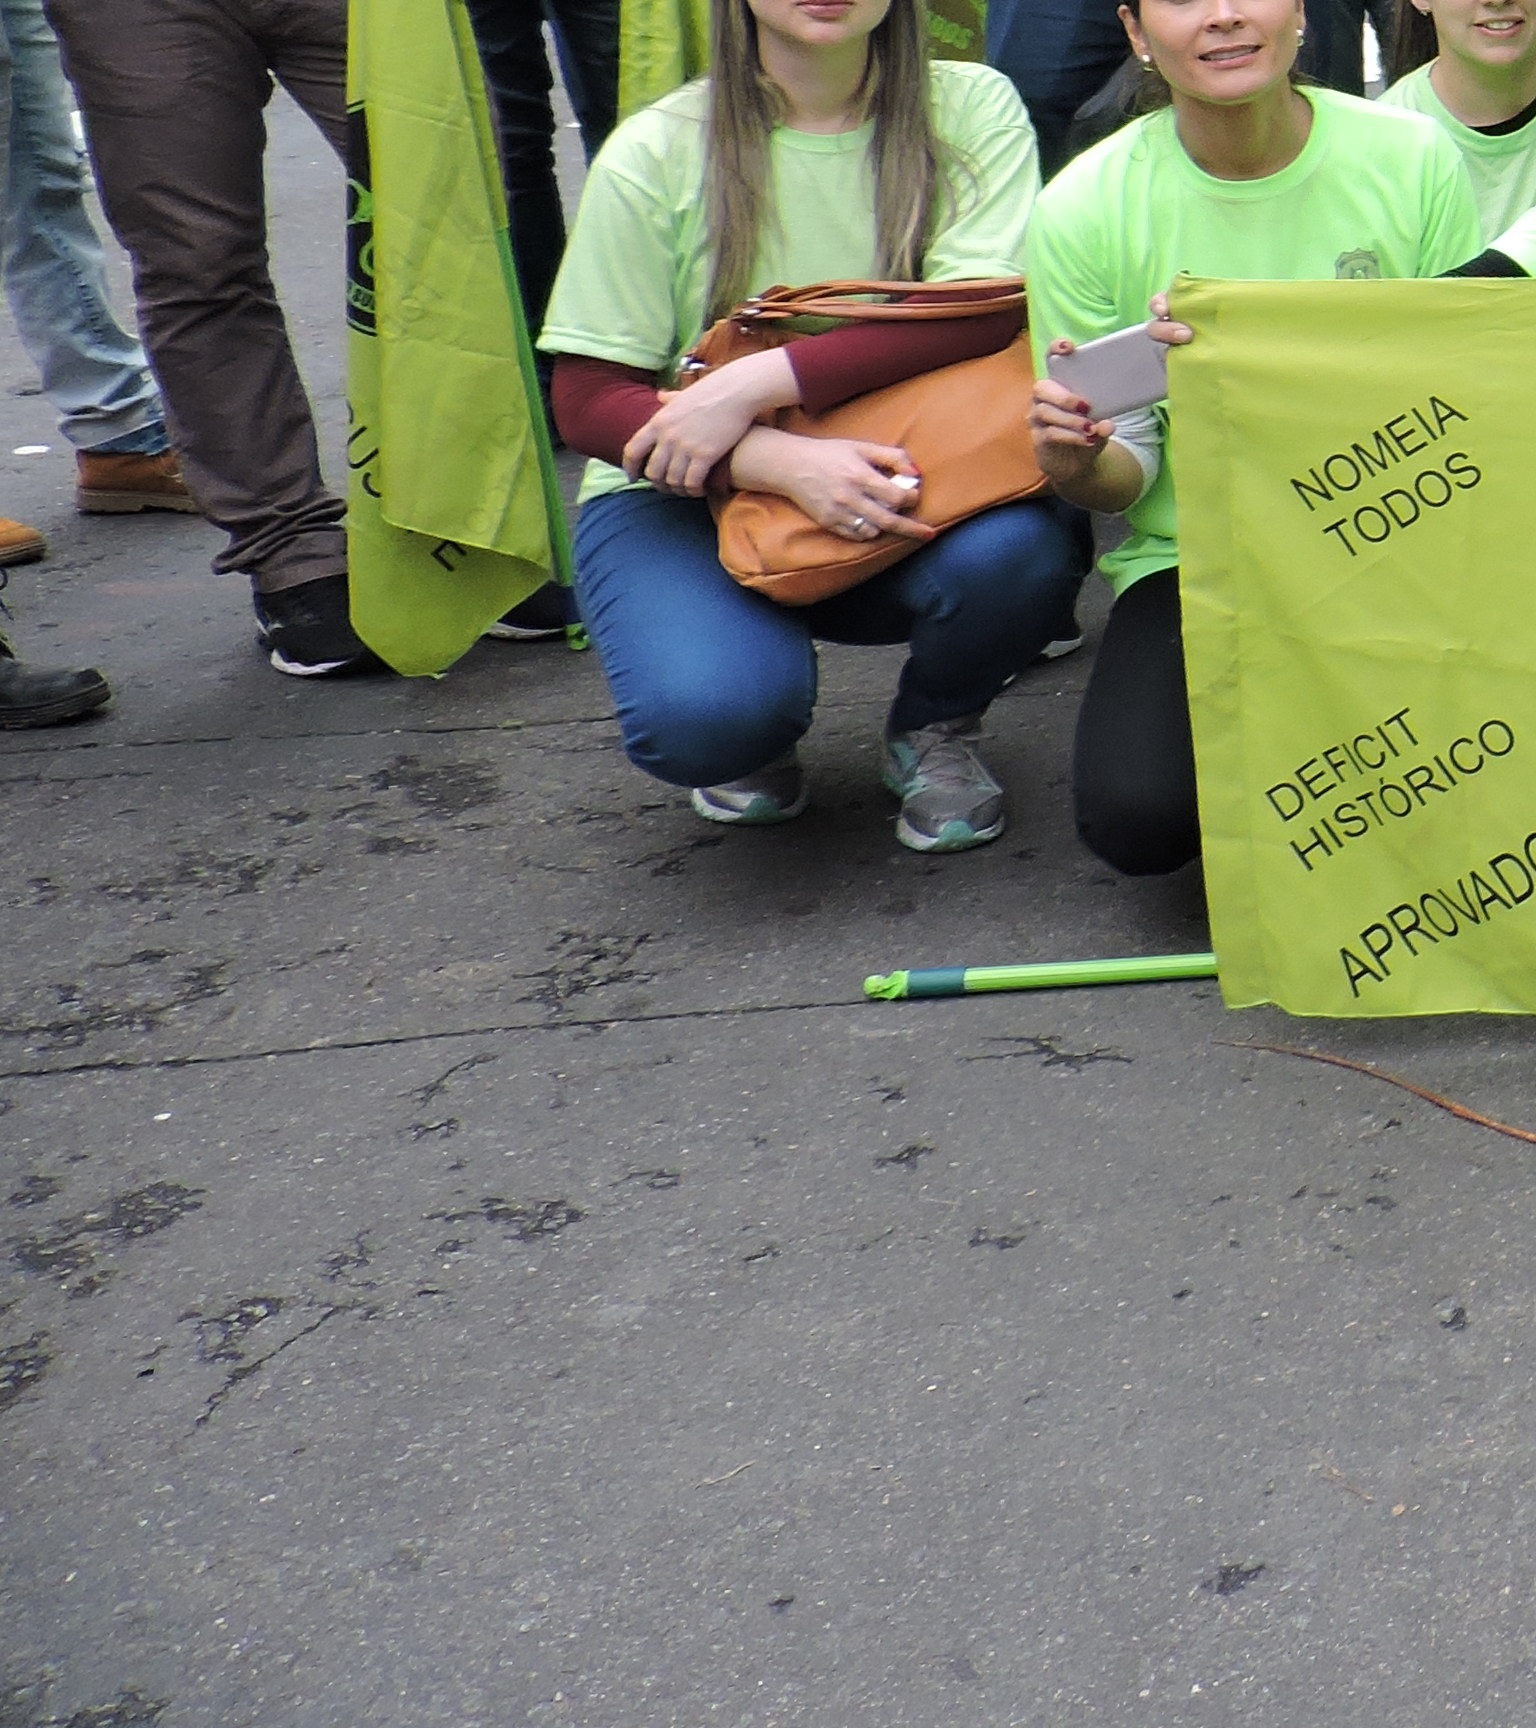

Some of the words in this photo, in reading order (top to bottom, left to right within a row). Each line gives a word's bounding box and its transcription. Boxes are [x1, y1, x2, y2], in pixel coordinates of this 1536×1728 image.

[1289, 394, 1469, 512] NOMEIA
[1322, 451, 1482, 559] TODOS
[1264, 706, 1420, 824] DEFICIT
[1288, 717, 1516, 872] HISTÓRICO
